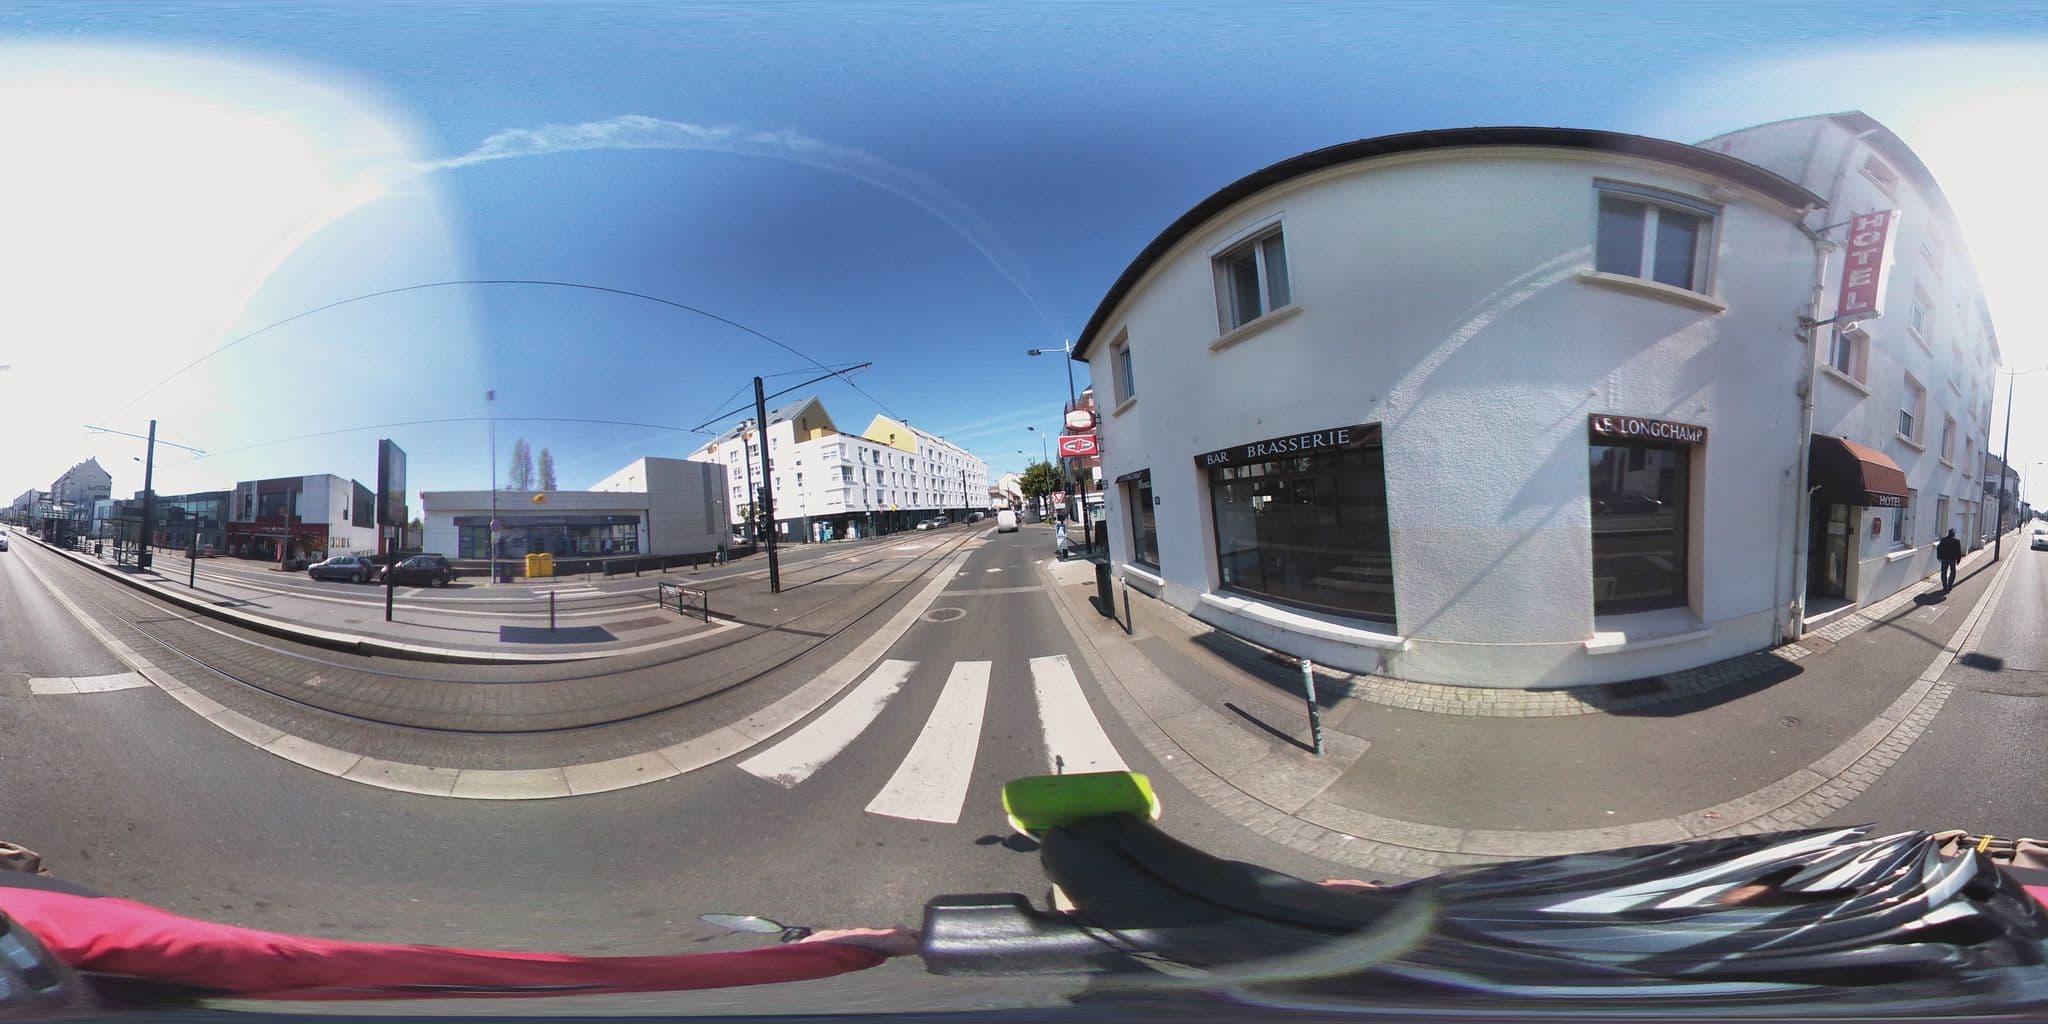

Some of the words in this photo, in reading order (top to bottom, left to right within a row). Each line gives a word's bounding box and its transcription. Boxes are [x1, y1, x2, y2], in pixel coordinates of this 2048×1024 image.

[1846, 214, 1885, 311] HOTEL
[1206, 451, 1230, 465] BAR
[1247, 429, 1350, 458] BRASSERIE
[1595, 417, 1612, 432] LE
[1621, 418, 1703, 442] LONGCHAMP
